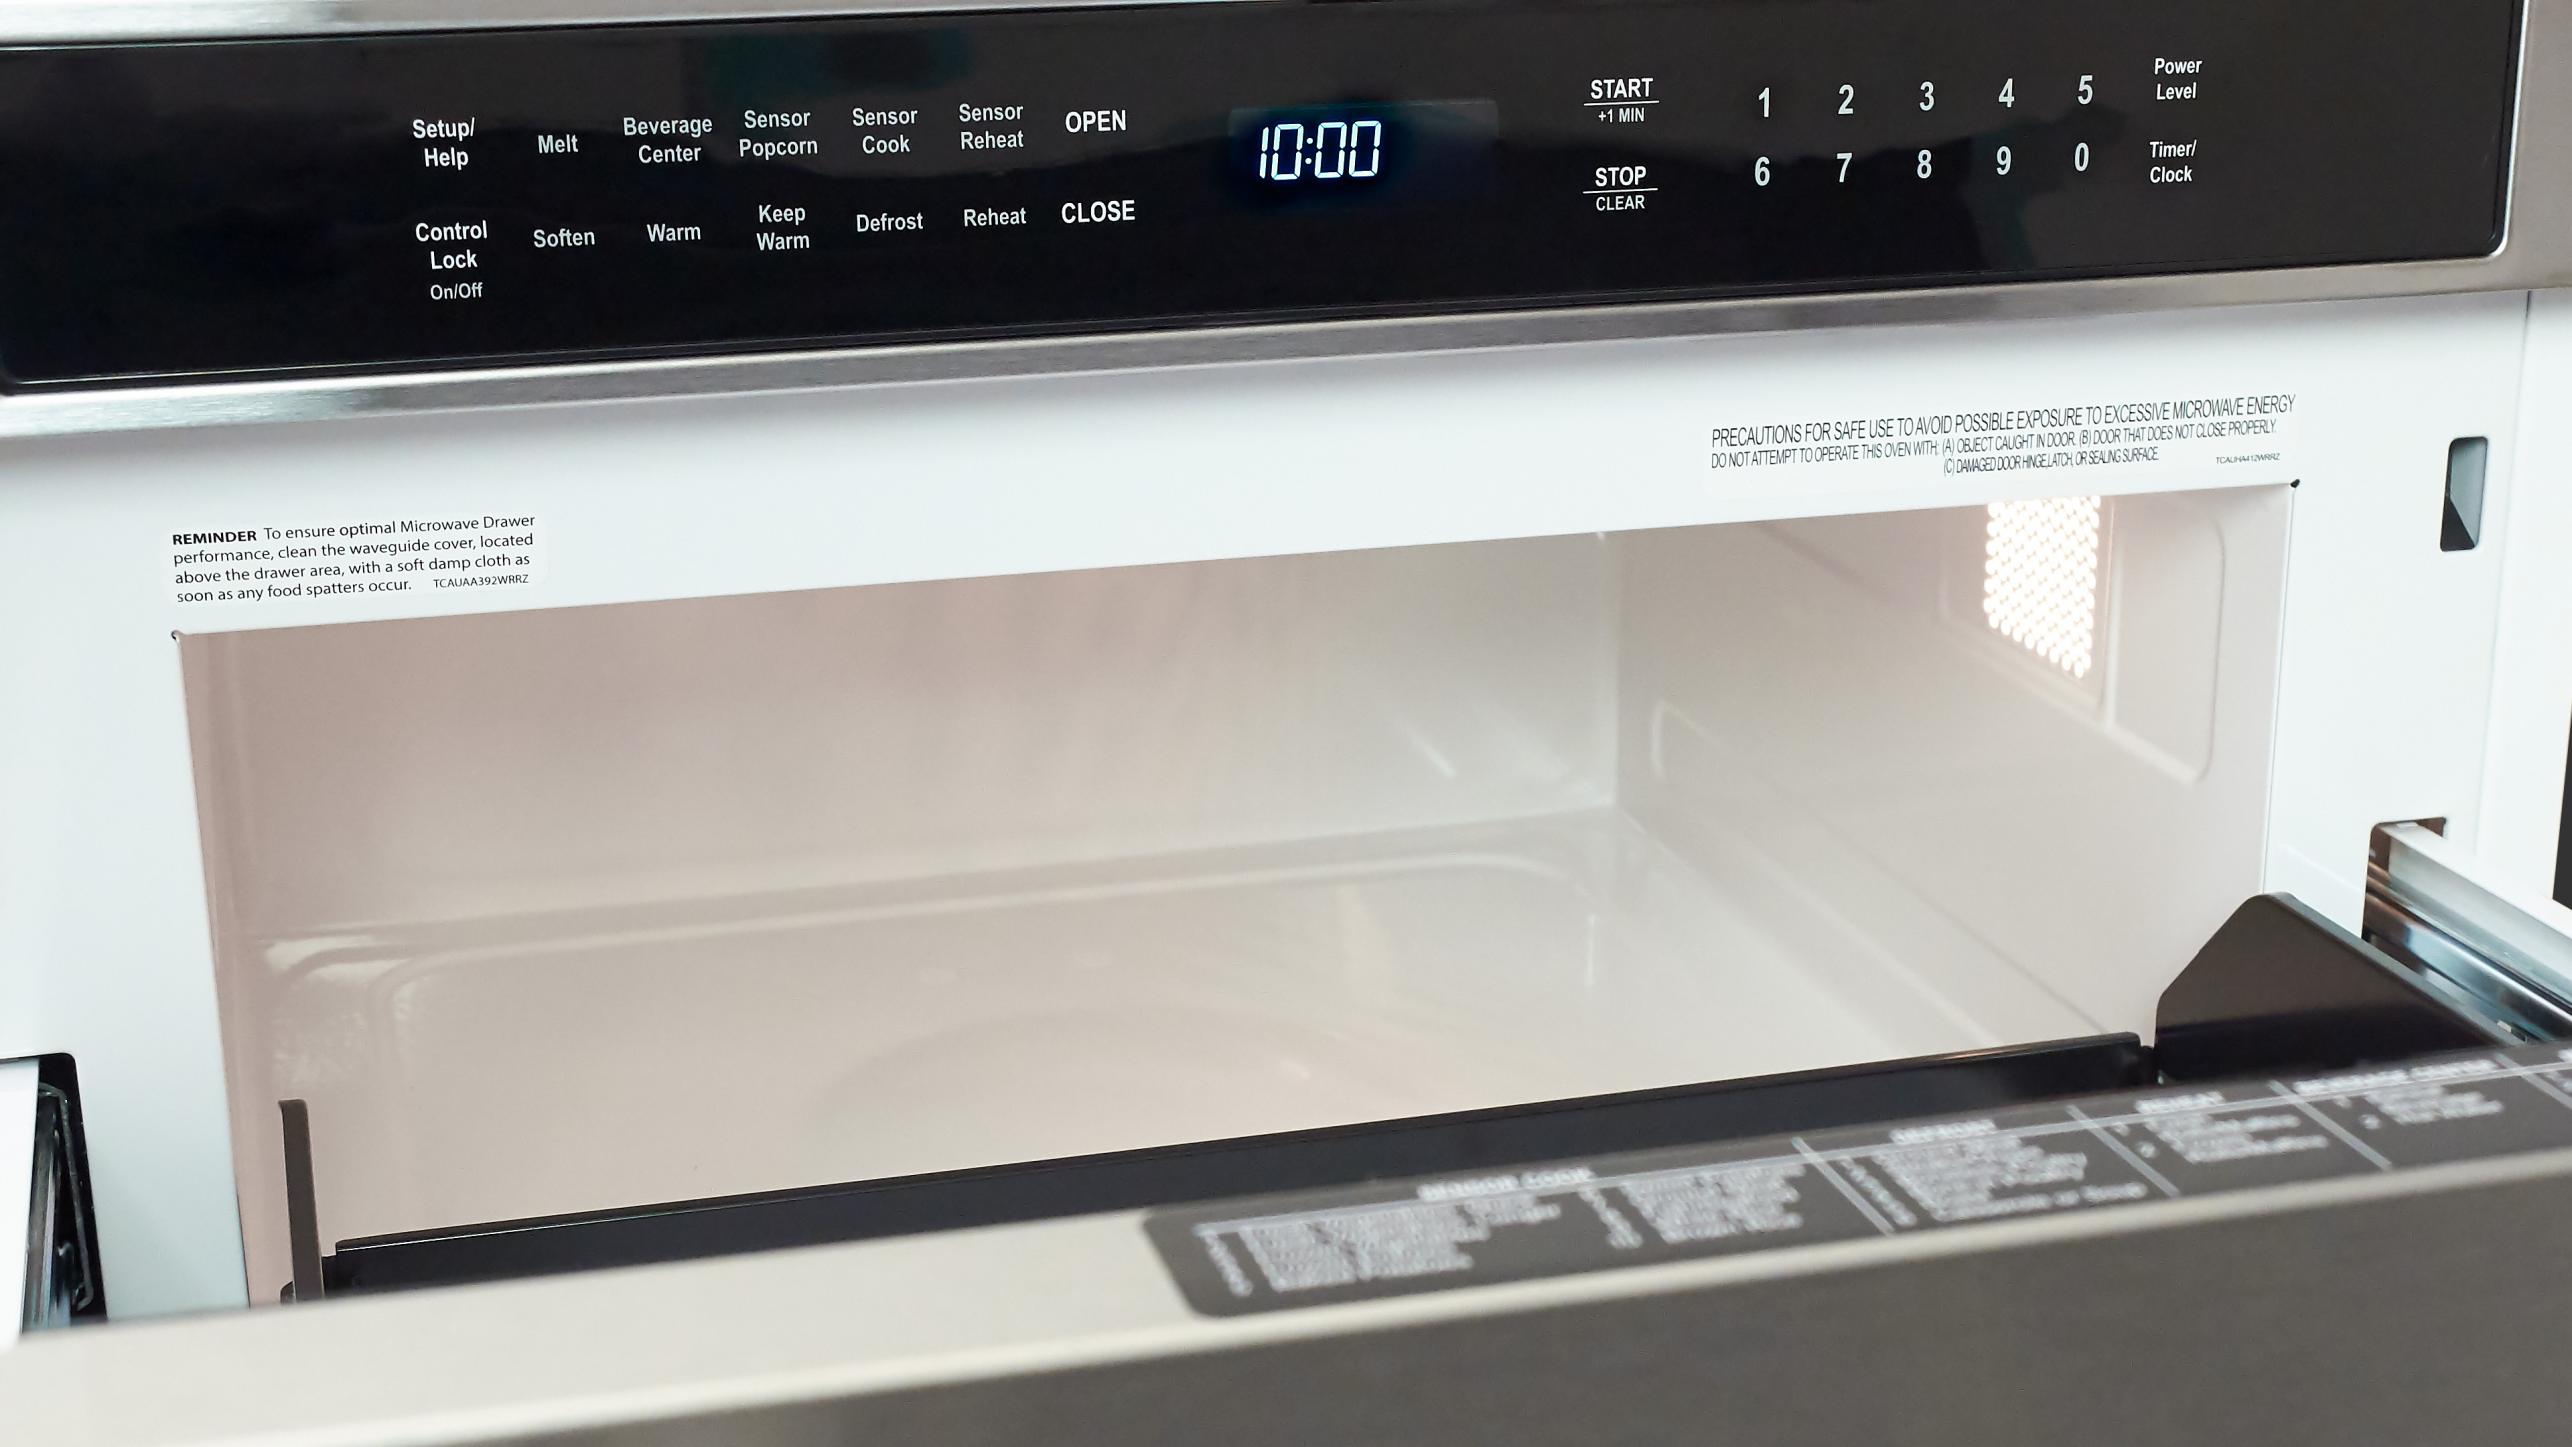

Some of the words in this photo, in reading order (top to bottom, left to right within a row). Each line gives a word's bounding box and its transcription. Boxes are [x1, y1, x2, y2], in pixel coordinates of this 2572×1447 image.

[2155, 58, 2202, 74] Power
[1591, 78, 1653, 99] START
[1759, 88, 1769, 117] 1
[1838, 85, 1853, 114] 2
[1920, 82, 1934, 111] 3
[1999, 78, 2014, 107] 4
[2078, 75, 2092, 104] 5
[2157, 82, 2196, 100] Level
[745, 110, 810, 128] Sensor
[853, 108, 917, 126] Sensor
[960, 104, 1023, 122] Sensor
[1066, 110, 1126, 132] OPEN
[1599, 109, 1612, 122] +1
[1619, 108, 1644, 122] MIN
[413, 117, 474, 141] Setup/
[624, 118, 712, 137] Beverage
[538, 134, 578, 153] Melt
[863, 135, 910, 153] Cook
[961, 130, 1023, 149] Reheat
[2150, 140, 2197, 158] Timer/
[425, 147, 468, 170] Help
[639, 145, 701, 163] Center
[740, 139, 817, 160] Popcorn
[1260, 121, 1381, 180] 10:00
[1755, 157, 1770, 186] 6
[1837, 153, 1852, 182] 7
[1917, 150, 1931, 178] 8
[1997, 146, 2011, 175] 9
[2075, 143, 2089, 171] 0
[2150, 165, 2192, 183] Clock
[1596, 166, 1646, 186] STOP
[1062, 200, 1135, 223] CLOSE
[1596, 195, 1645, 211] CLEAR
[759, 205, 805, 225] Keep
[857, 213, 923, 232] Defrost
[964, 208, 1026, 226] Reheat
[416, 220, 487, 241] Control
[534, 229, 595, 247] Soften
[647, 224, 700, 242] Warm
[757, 232, 809, 250] Warm
[431, 249, 477, 269] Lock
[431, 282, 482, 299] On/Off
[1712, 424, 1801, 448] PRECAUTIONS
[1805, 422, 1832, 442] FOR
[1833, 420, 1866, 441] SAFE
[1869, 418, 1894, 439] USE
[1897, 417, 1914, 436] TO
[1915, 415, 1953, 436] AVOID
[1955, 411, 2014, 433] POSSIBLE
[2016, 407, 2083, 430] EXPOSURE
[2085, 405, 2101, 425] TO
[2104, 401, 2171, 424] EXCESSIVE
[2172, 397, 2244, 419] MICROWAVE
[2247, 394, 2296, 415] ENERGY
[1711, 452, 1726, 469] DO
[1729, 450, 1751, 468] NOT
[1751, 448, 1798, 467] ATTEMPT
[1800, 447, 1813, 464] TO
[1814, 445, 1860, 463] OPERATE
[1861, 443, 1883, 460] THIS
[1884, 441, 1912, 458] OVEN
[1942, 438, 1954, 458] (A)
[1956, 436, 1994, 454] OBJECT
[1995, 433, 2035, 451] CAUGHT
[2036, 432, 2046, 449] IN
[2079, 429, 2092, 448] (B)
[2093, 427, 2121, 445] DOOR
[2123, 426, 2146, 443] THAT
[2147, 424, 2174, 442] DOES
[2174, 423, 2196, 440] NOT
[2197, 421, 2227, 439] CLOSE
[1944, 458, 1955, 477] (C)
[1956, 457, 1997, 473] DAMAGED
[1997, 456, 2021, 471] DOOR
[2075, 451, 2087, 467] OR
[2088, 449, 2122, 465] SEALING
[172, 530, 257, 546] REMINDER
[263, 526, 281, 541] To
[285, 526, 335, 539] ensure
[339, 521, 396, 540] optimal
[400, 517, 479, 534] Microwave
[483, 515, 535, 530] Drawer
[174, 547, 274, 566] performance,
[278, 545, 317, 560] clean
[321, 543, 346, 557] the
[349, 539, 430, 557] waveguide
[434, 536, 477, 552] cover,
[480, 533, 534, 549] located
[175, 570, 221, 584] above
[225, 567, 250, 582] the
[254, 564, 305, 580] drawer
[310, 563, 345, 578] area,
[349, 560, 381, 575] with
[385, 563, 394, 573] a
[397, 558, 425, 573] soft
[428, 555, 471, 573] damp
[475, 553, 511, 568] cloth
[515, 555, 530, 566] as
[177, 589, 214, 603] soon
[218, 589, 233, 600] as
[237, 587, 263, 602] any
[267, 584, 302, 598] food
[306, 580, 365, 598] spatters
[368, 579, 412, 593] occur.
[433, 574, 529, 589] TCAUAA392WRRZ
